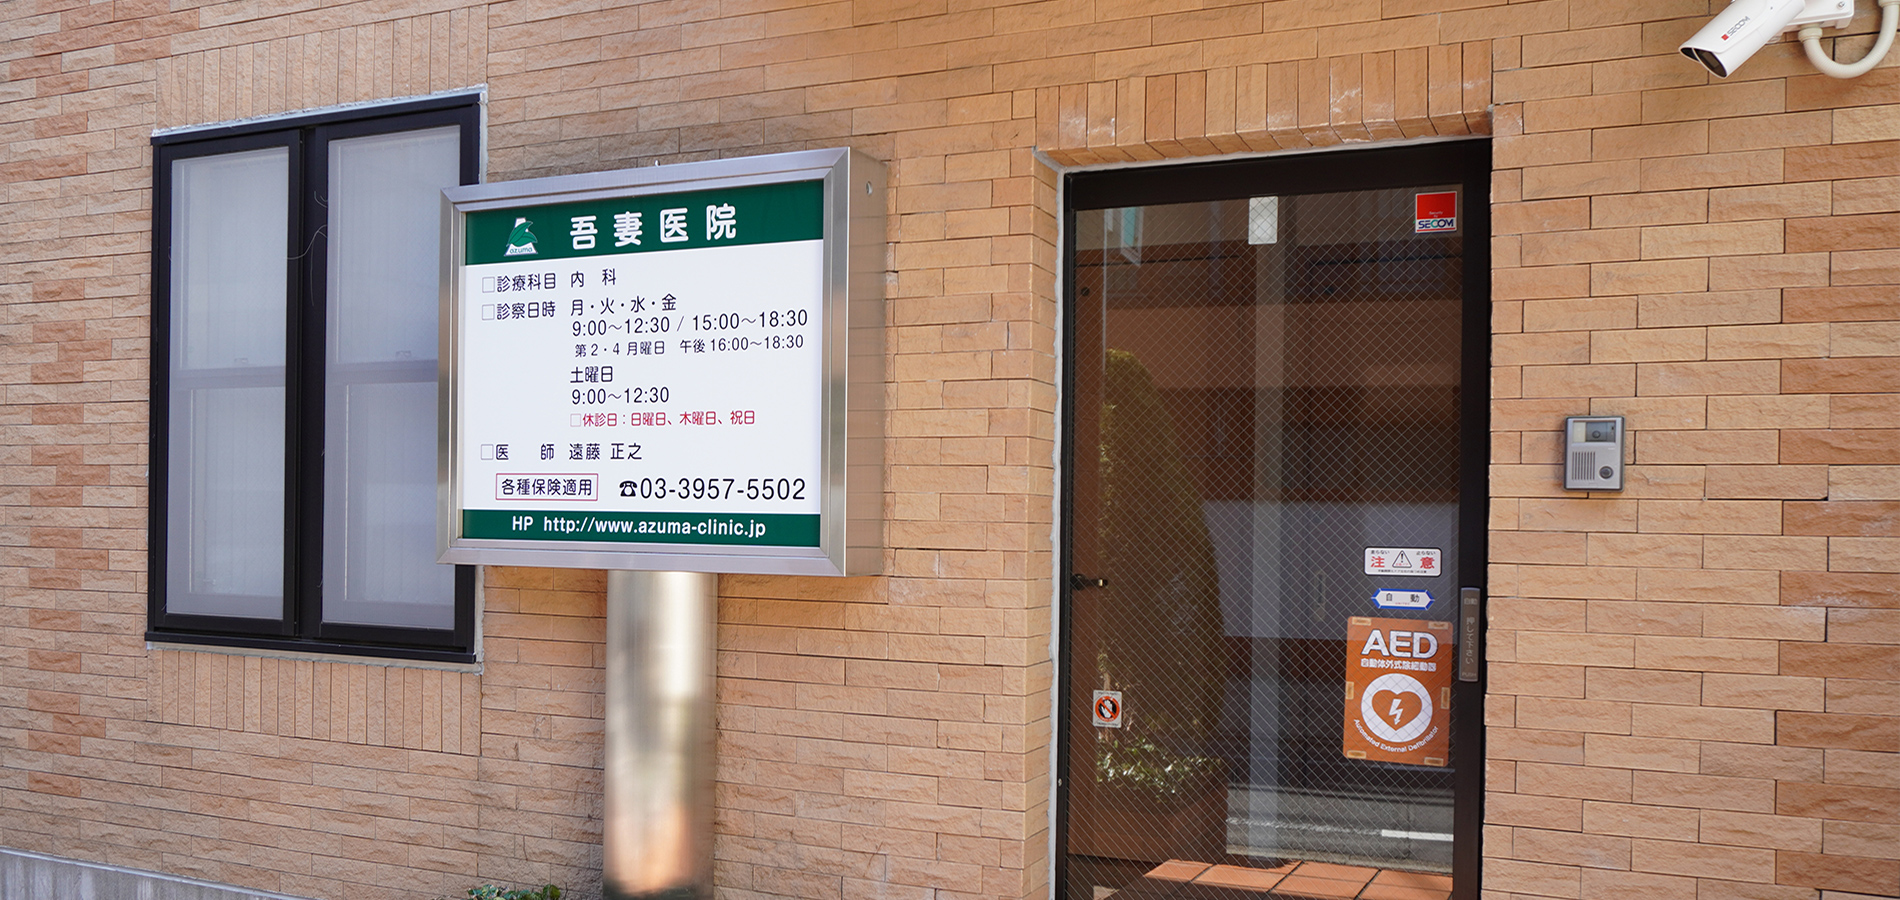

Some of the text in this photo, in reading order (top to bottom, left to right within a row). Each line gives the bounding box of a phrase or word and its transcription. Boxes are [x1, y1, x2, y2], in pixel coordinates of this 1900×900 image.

[1727, 16, 1751, 37] SECOM
[569, 202, 738, 250] 吾妻医院
[1418, 219, 1454, 229] SECOM
[496, 272, 557, 293] 診療科目
[496, 300, 556, 321] 診察日時
[570, 365, 614, 384] 土曜日
[501, 478, 593, 496] 各種保険適用
[640, 478, 806, 501] 03-3957-5502
[512, 515, 766, 537] HP http://www.azuma-clinic.jp
[1361, 629, 1438, 659] AED
[1360, 658, 1437, 672] 自動体外式除細動器
[1353, 718, 1439, 753] Automated External Defibrillator
